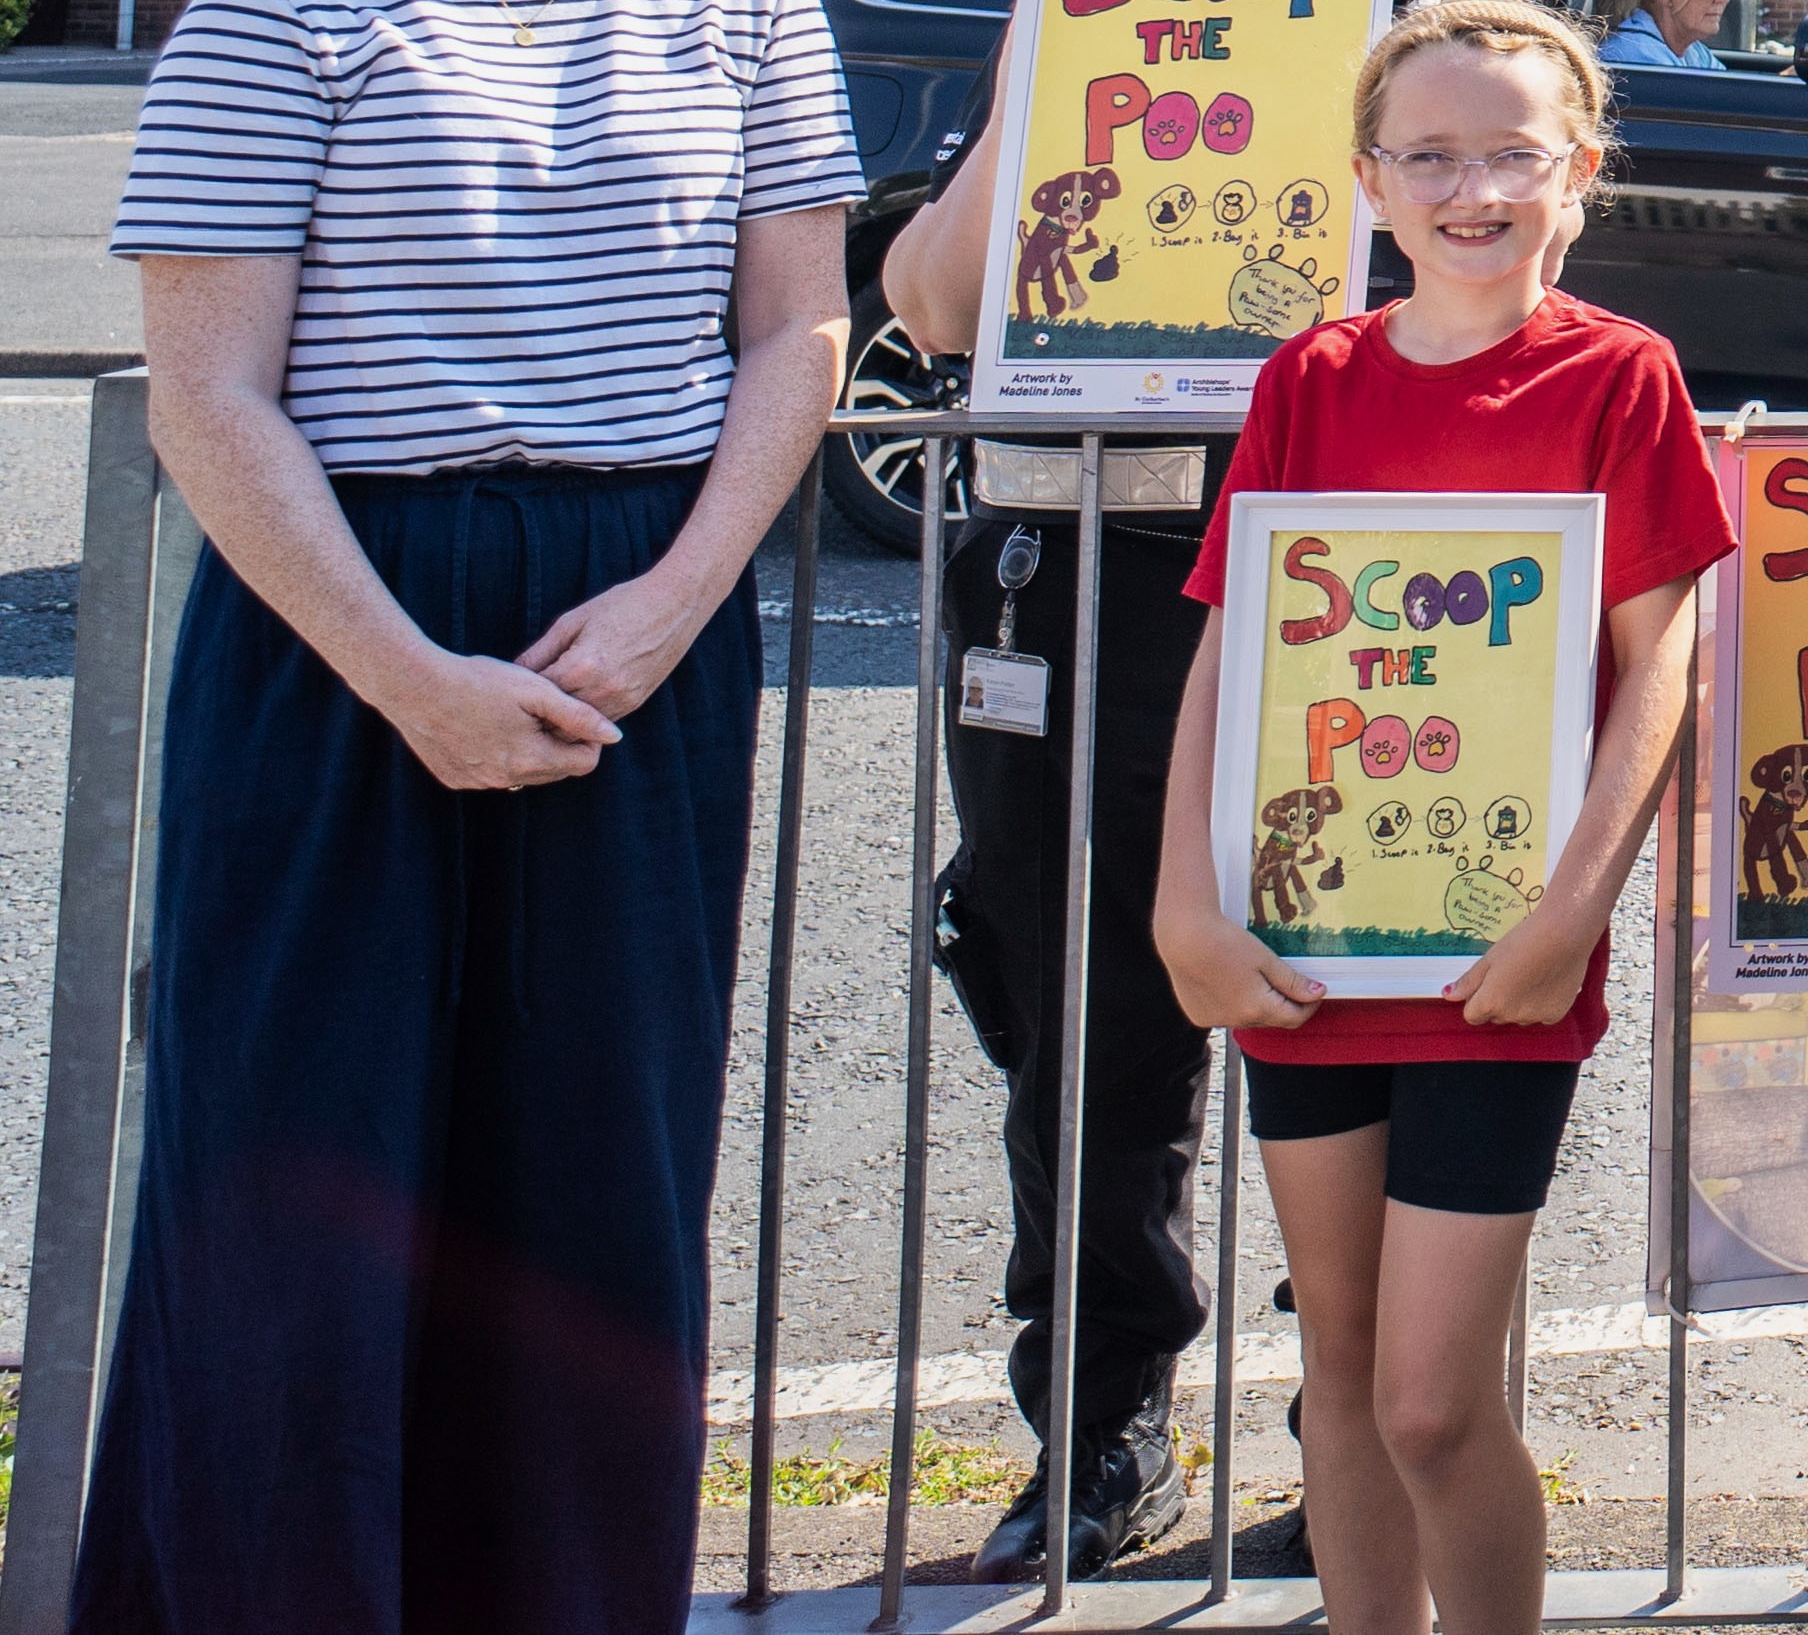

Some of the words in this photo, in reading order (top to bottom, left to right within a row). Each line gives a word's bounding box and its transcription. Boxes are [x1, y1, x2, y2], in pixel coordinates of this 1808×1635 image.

[1136, 17, 1232, 64] THE
[1085, 73, 1254, 166] POO
[999, 384, 1048, 398] Madeline
[1050, 384, 1083, 397] Jones
[1011, 373, 1057, 385] Artwork
[1059, 373, 1074, 386] by
[1348, 645, 1438, 691] THE
[1305, 697, 1461, 785] POO
[1735, 966, 1788, 979] Madeline
[1747, 952, 1795, 965] Artwork
